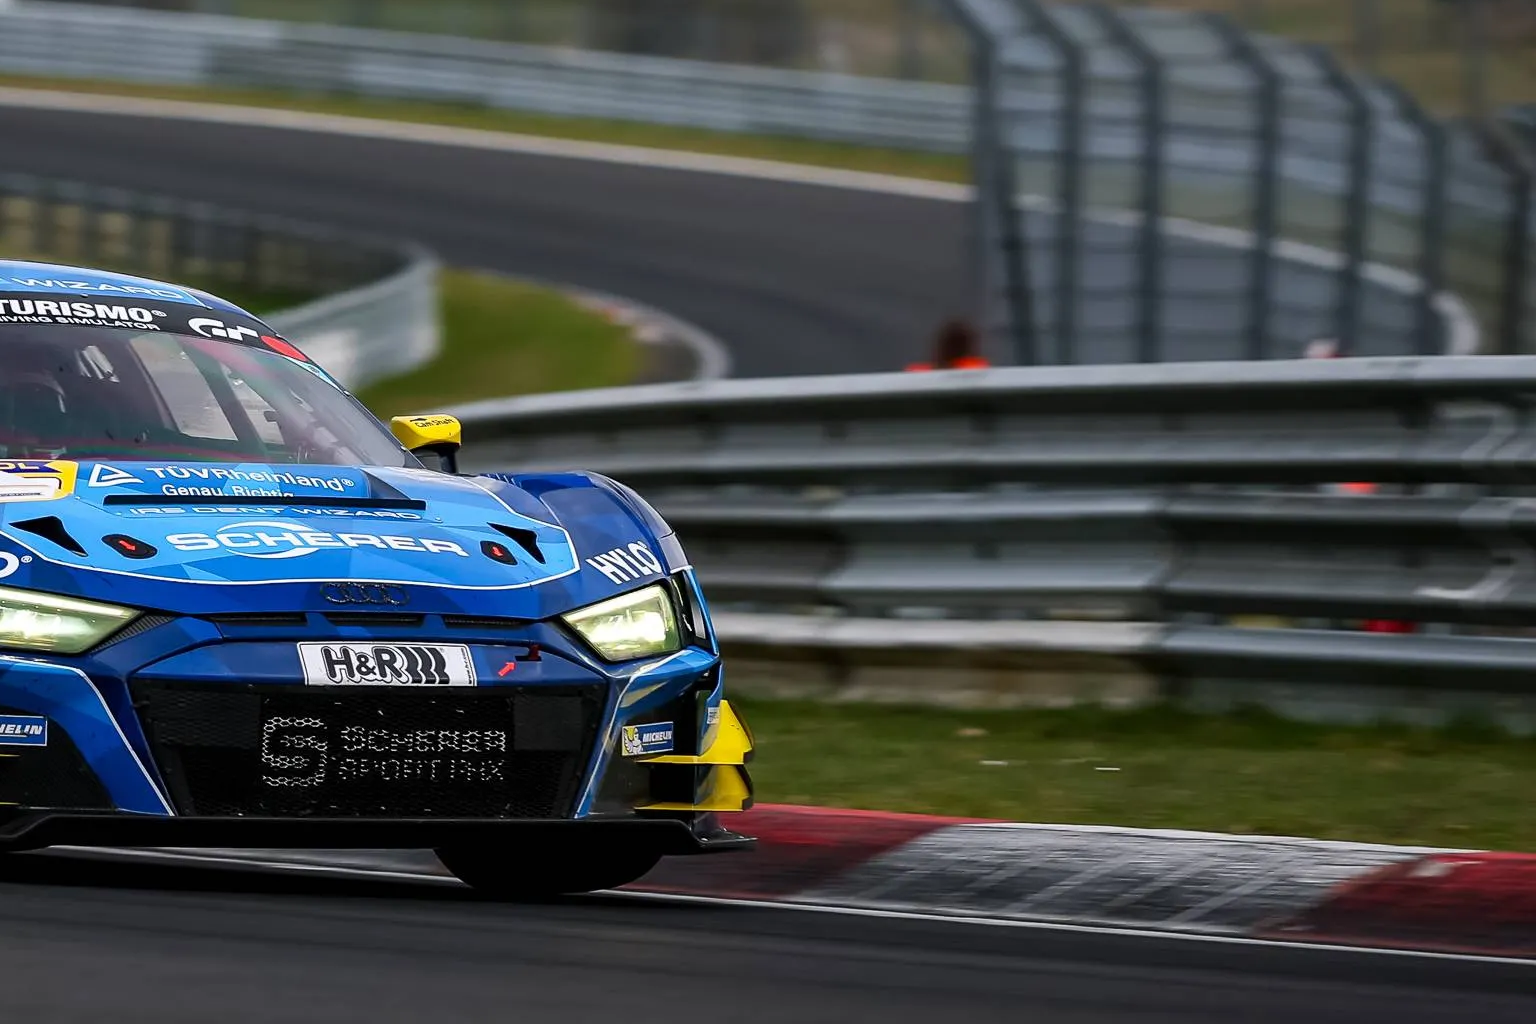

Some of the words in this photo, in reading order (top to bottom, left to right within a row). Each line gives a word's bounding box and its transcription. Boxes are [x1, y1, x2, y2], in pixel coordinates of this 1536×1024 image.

[11, 277, 184, 299] WIZARD
[56, 316, 161, 331] SIMULATOR
[161, 484, 228, 497] Genau.
[129, 507, 187, 515] IRS
[192, 506, 285, 514] DENT
[292, 507, 424, 521] WIZARD
[164, 531, 470, 558] SCHERER
[321, 645, 409, 684] H&R
[642, 730, 673, 743] MICHELIN
